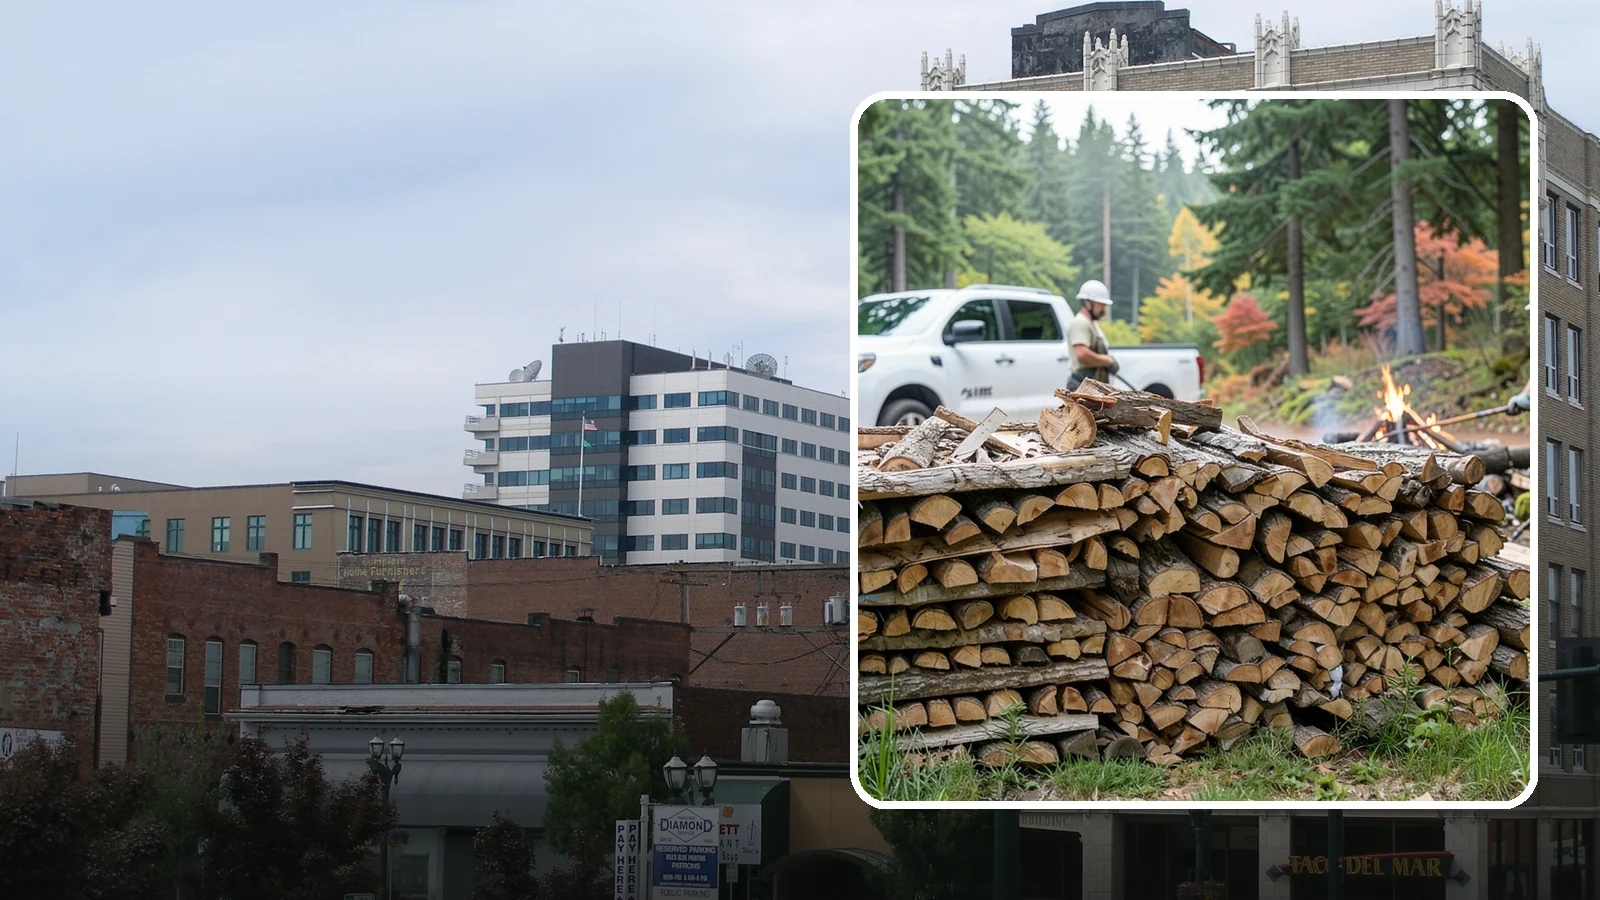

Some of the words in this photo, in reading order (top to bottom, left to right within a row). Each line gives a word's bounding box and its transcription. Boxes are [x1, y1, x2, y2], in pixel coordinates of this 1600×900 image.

[370, 566, 427, 577] Furnishers
[660, 818, 713, 833] DIAMOND
[1021, 815, 1070, 828] BUILDING
[617, 825, 625, 852] PAY
[628, 824, 637, 852] PAY
[721, 851, 739, 863] Soup
[671, 862, 701, 870] PATRONS
[1289, 855, 1329, 875] TAC
[1346, 856, 1385, 876] DEL
[1392, 857, 1443, 877] MAR
[616, 856, 625, 893] HERE
[627, 855, 637, 893] HERE
[660, 888, 682, 897] PUBLIC
[683, 889, 710, 898] PARKING
